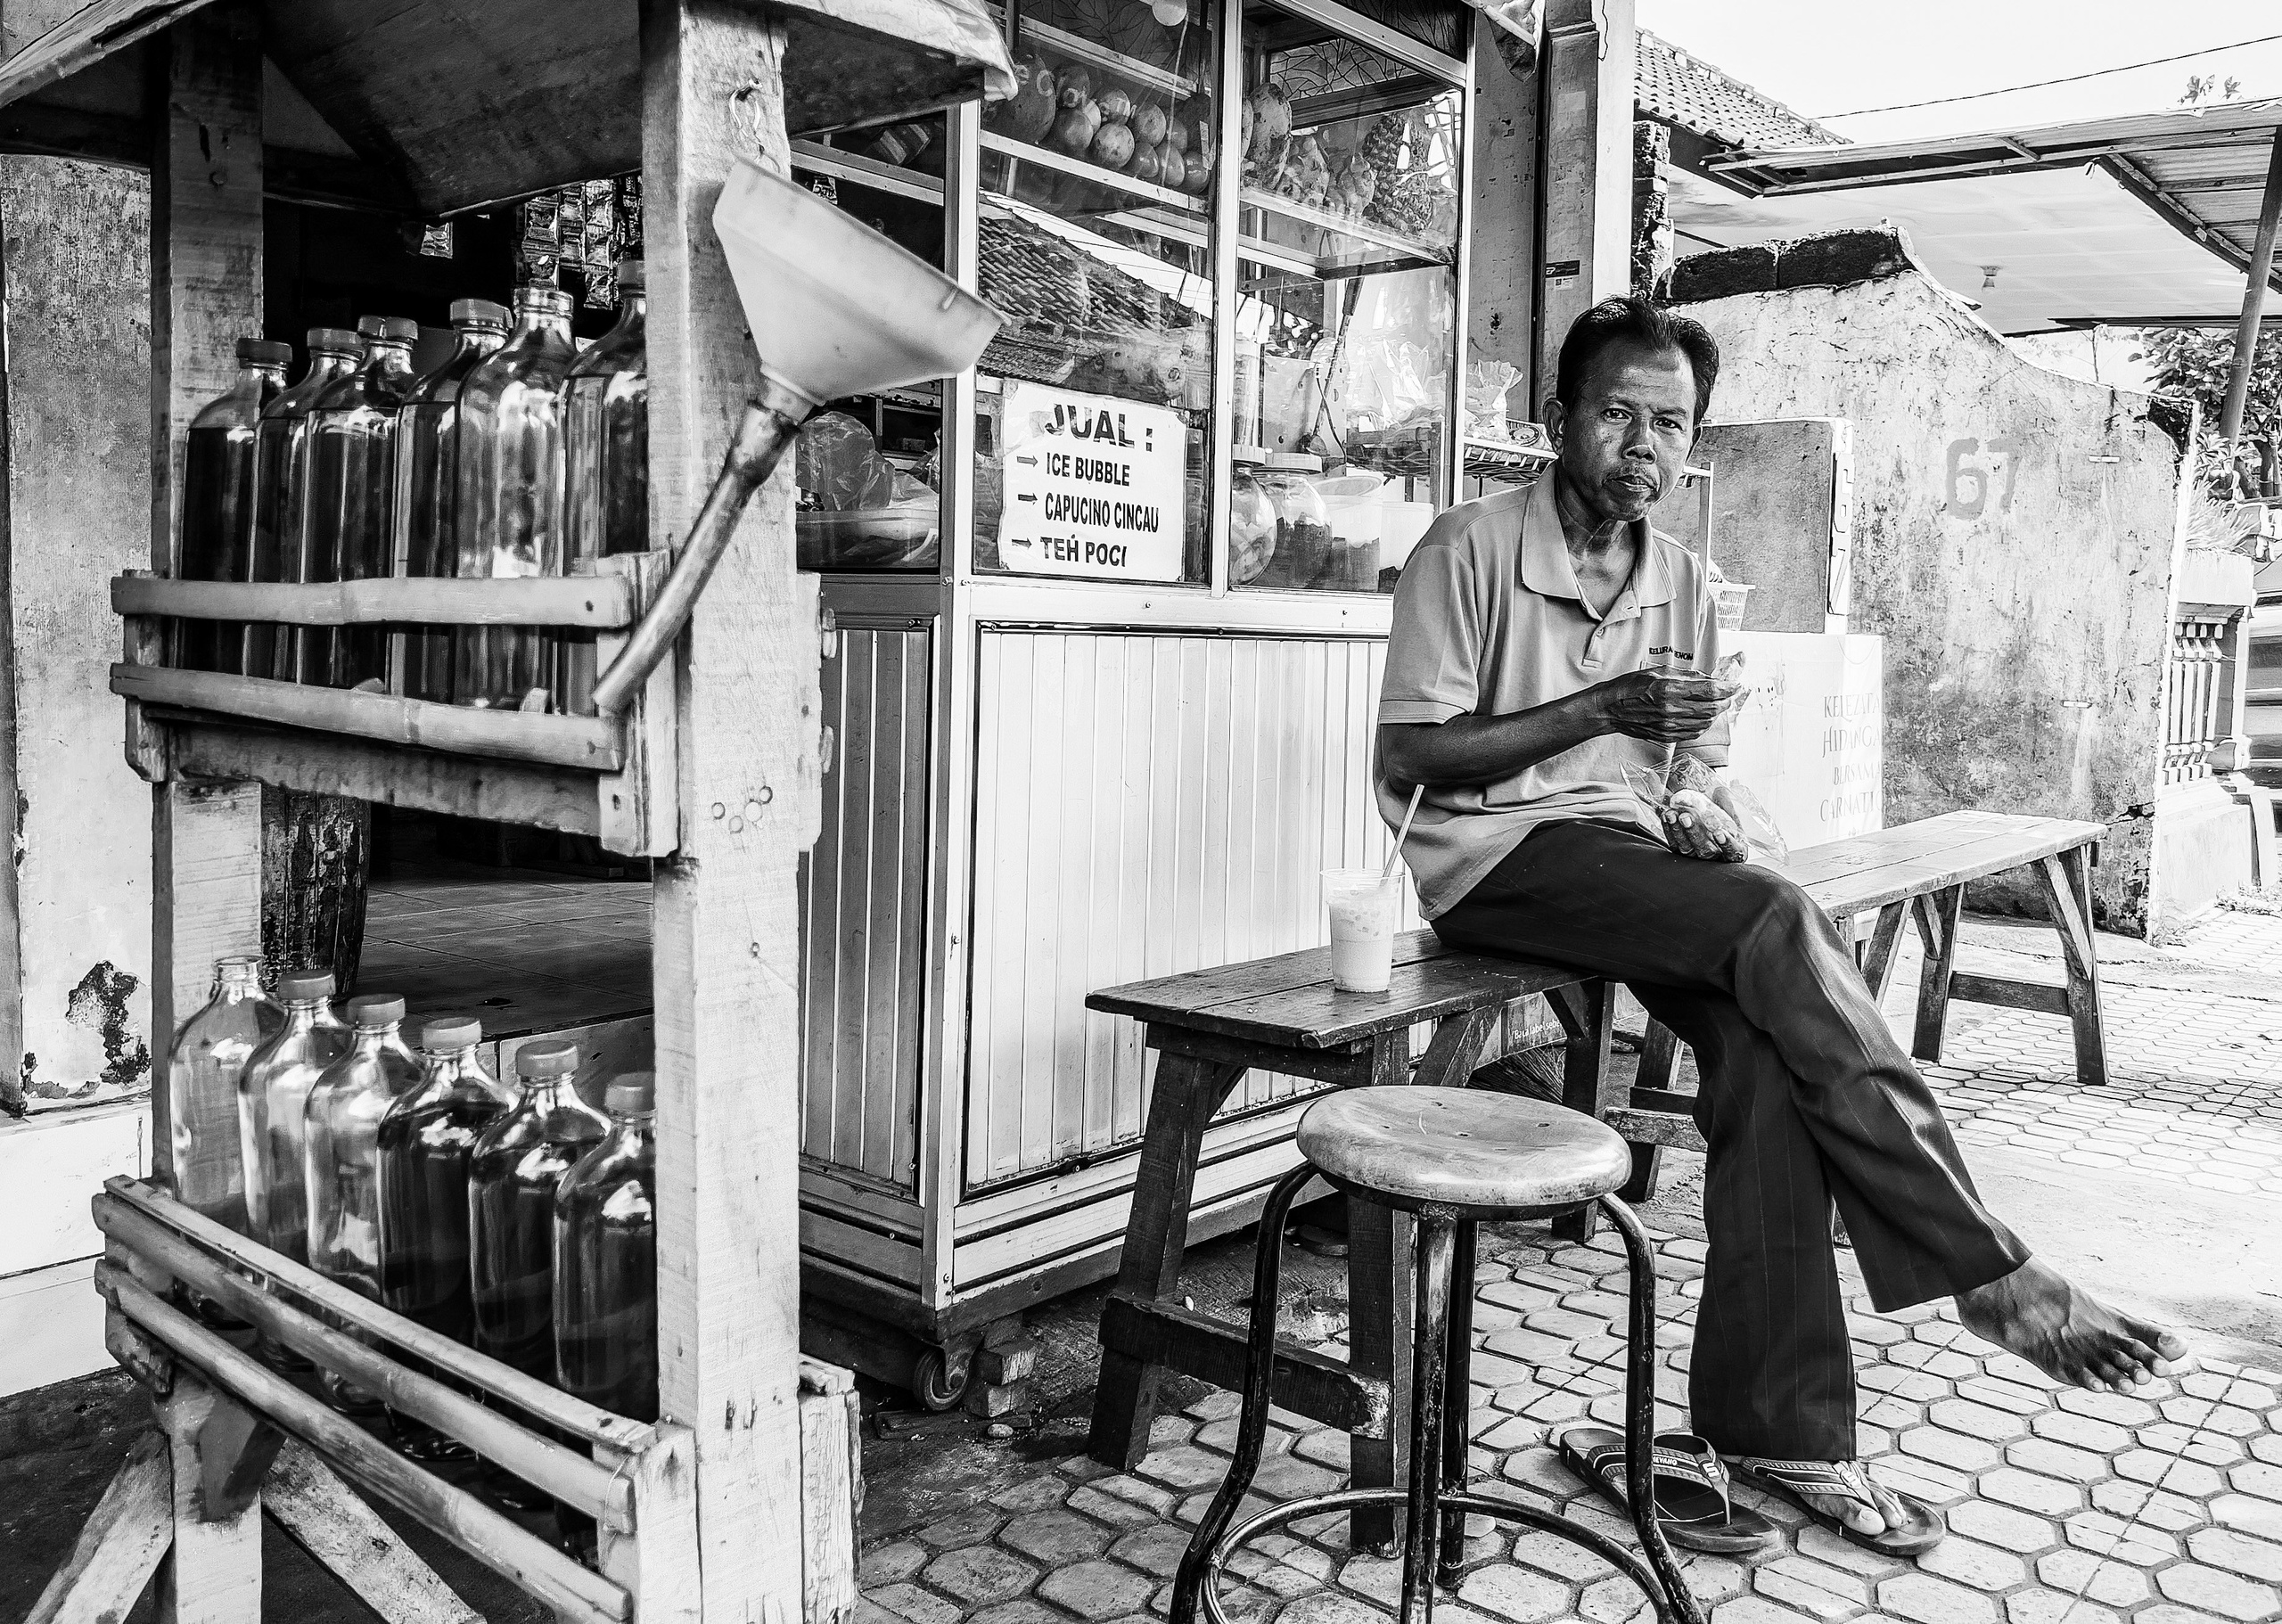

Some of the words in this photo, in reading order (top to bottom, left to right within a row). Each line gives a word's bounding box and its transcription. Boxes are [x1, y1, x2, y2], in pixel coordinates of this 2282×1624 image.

[1045, 404, 1135, 447] JUAL
[1047, 452, 1070, 477] ICE
[1075, 457, 1130, 486] BUBBLE
[1946, 437, 2023, 521] 67
[1046, 492, 1110, 527] CAPUCINO
[1114, 502, 1159, 533] CINCAU
[1040, 534, 1079, 562] TEH
[1086, 542, 1127, 567] POCI
